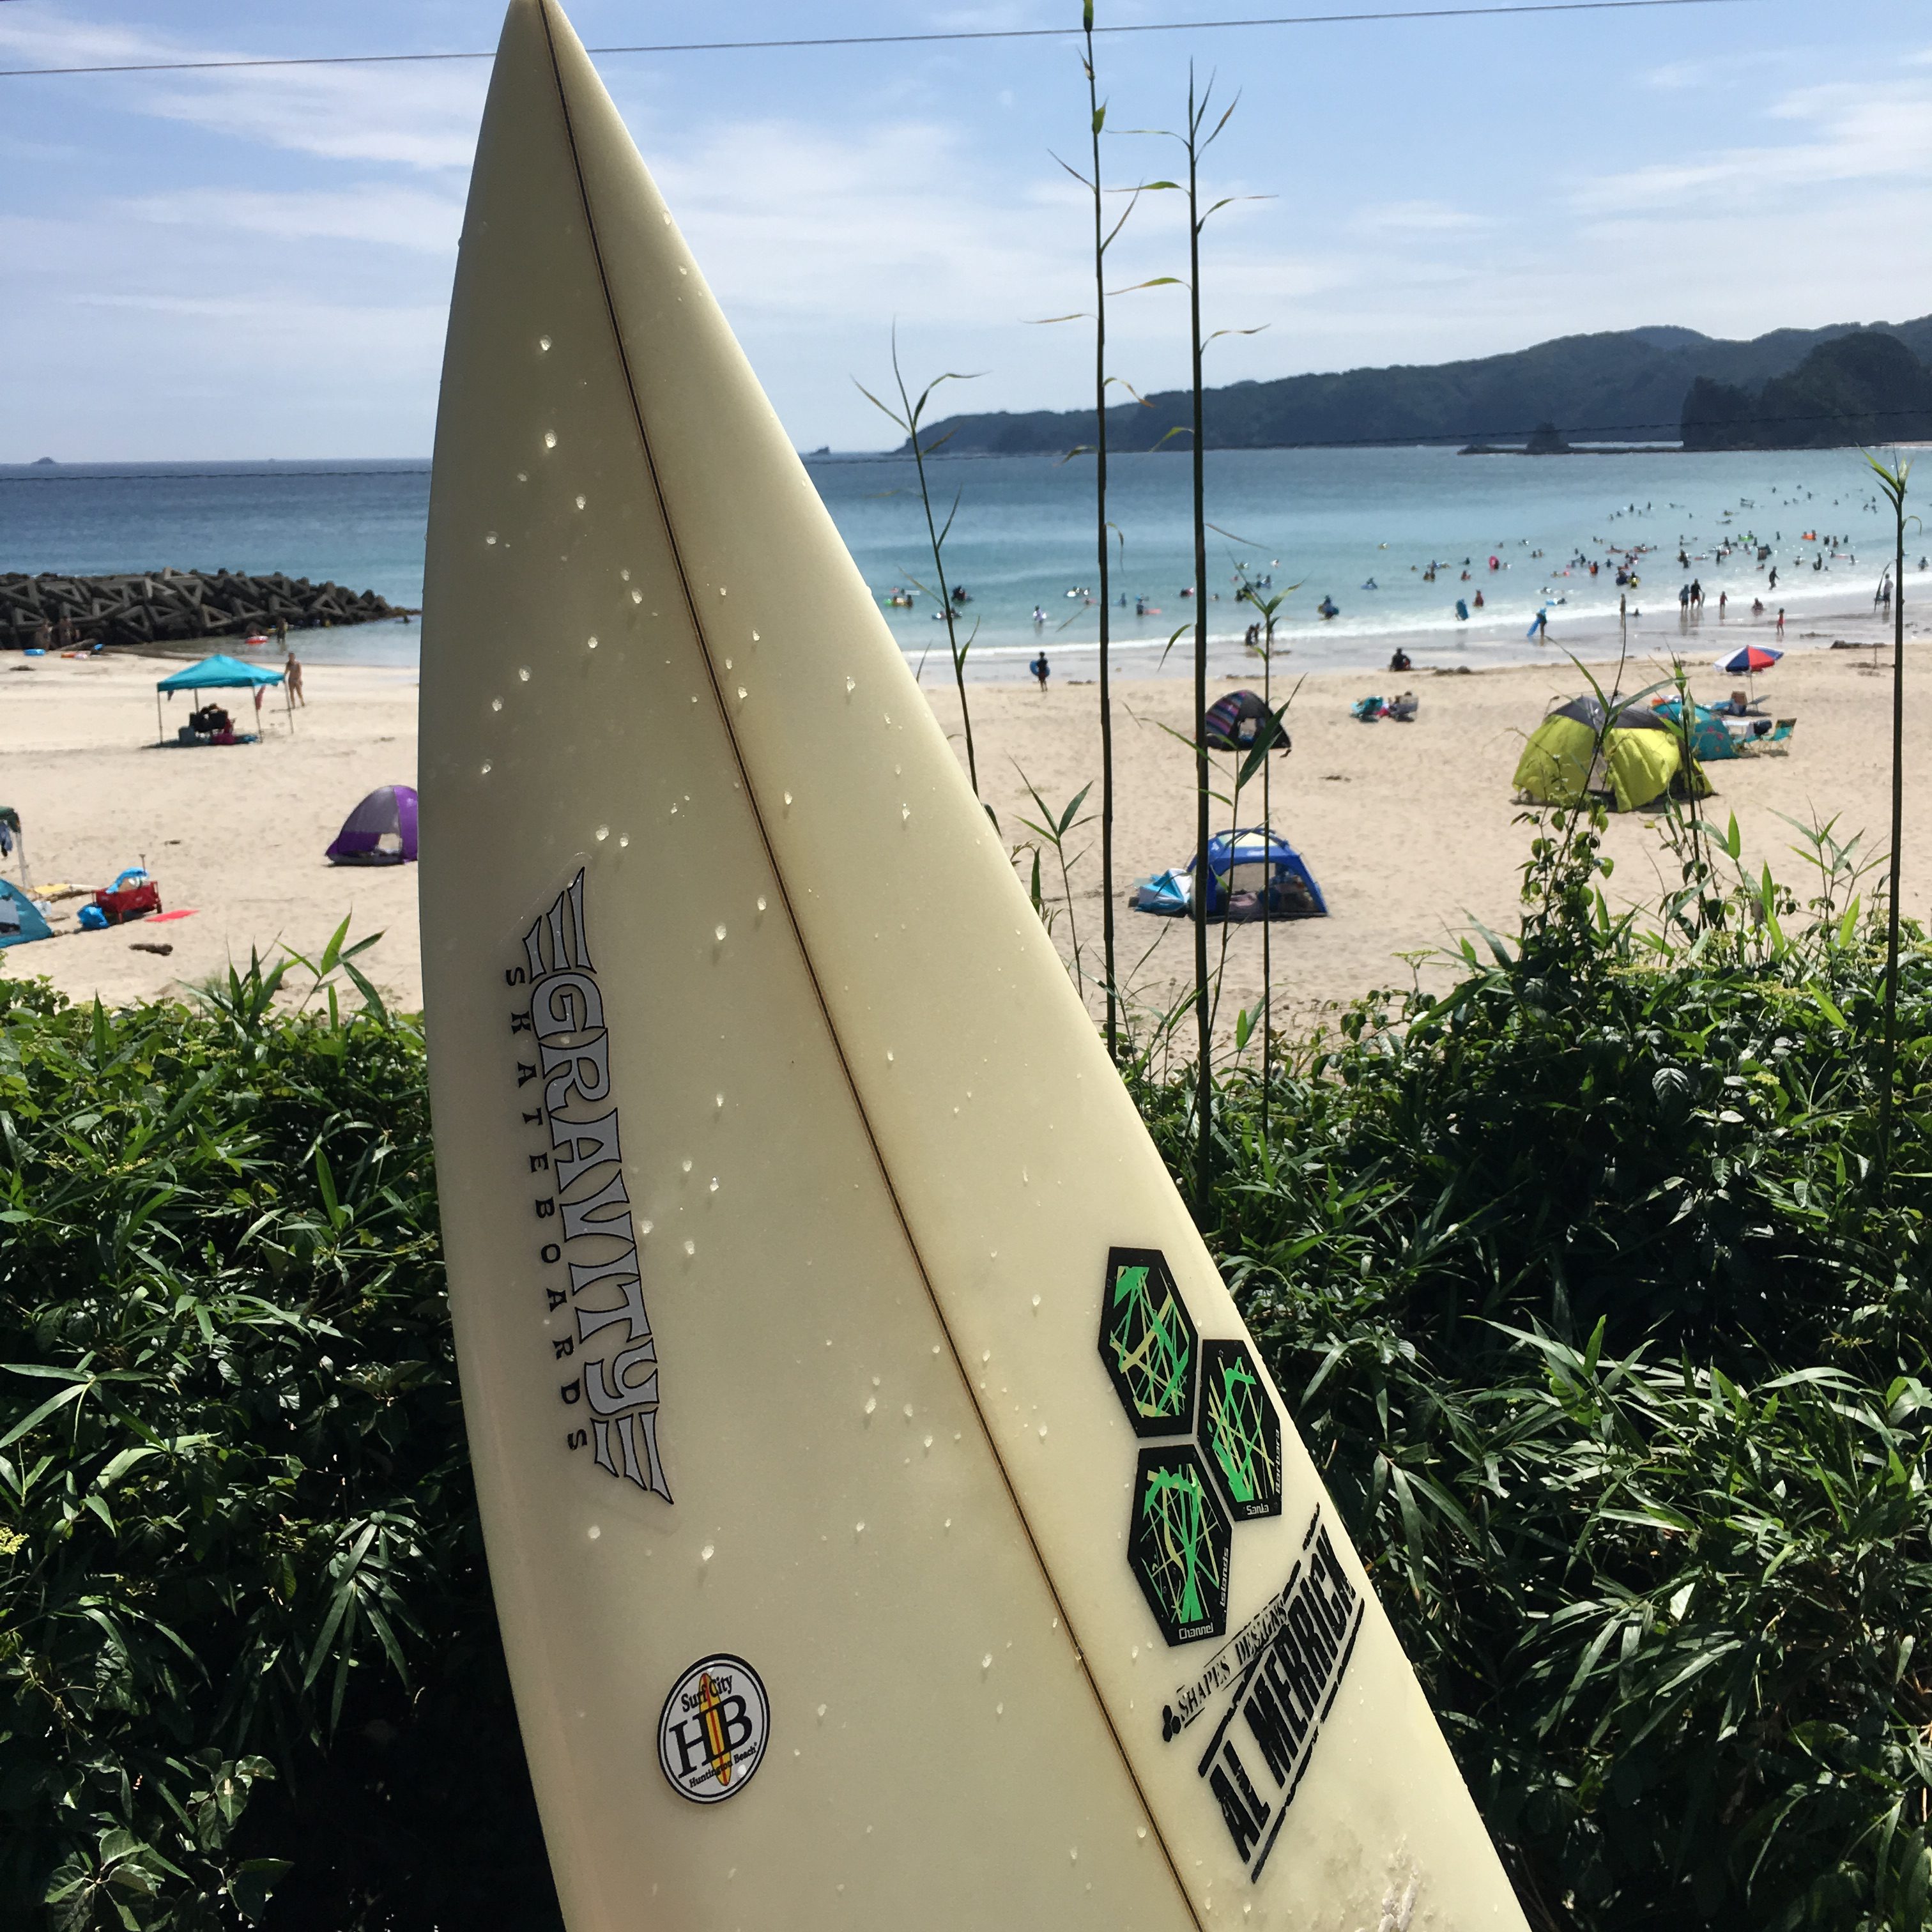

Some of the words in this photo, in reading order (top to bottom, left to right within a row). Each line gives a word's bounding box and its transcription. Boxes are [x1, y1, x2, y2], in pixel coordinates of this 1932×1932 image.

[493, 967, 587, 1450] SKATEBOARDS
[531, 972, 659, 1415] GRAVITY
[1246, 1503, 1269, 1515] Santa
[1179, 1622, 1213, 1639] Channel
[1220, 1547, 1229, 1607] Islands
[681, 1683, 707, 1712] Surf
[709, 1675, 732, 1697] City
[1179, 1655, 1230, 1721] SHAPES
[1235, 1600, 1287, 1666] DESIGNS
[1209, 1741, 1271, 1864] AL
[1243, 1523, 1356, 1788] MERRICK
[669, 1695, 752, 1779] HB
[689, 1760, 733, 1788] Huntington
